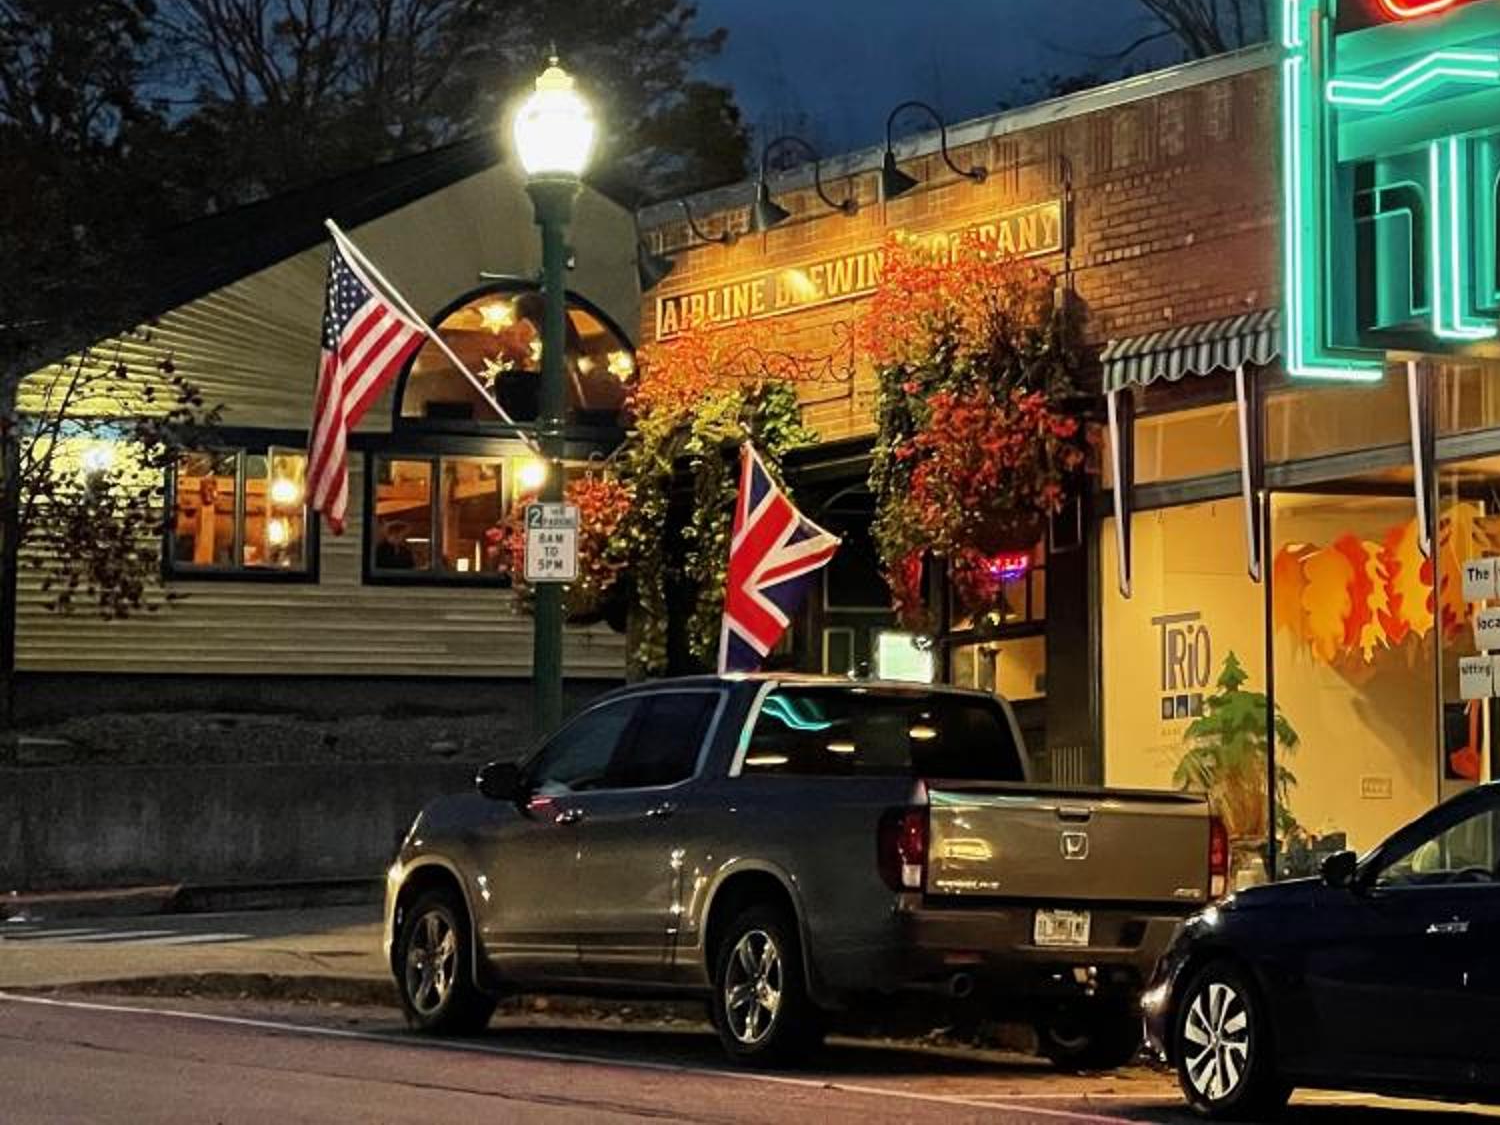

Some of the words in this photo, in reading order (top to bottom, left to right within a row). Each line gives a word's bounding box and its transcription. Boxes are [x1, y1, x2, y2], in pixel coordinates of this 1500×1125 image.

[529, 507, 541, 527] 2
[544, 547, 559, 557] TO
[1467, 568, 1490, 582] The
[1461, 662, 1491, 676] sitting
